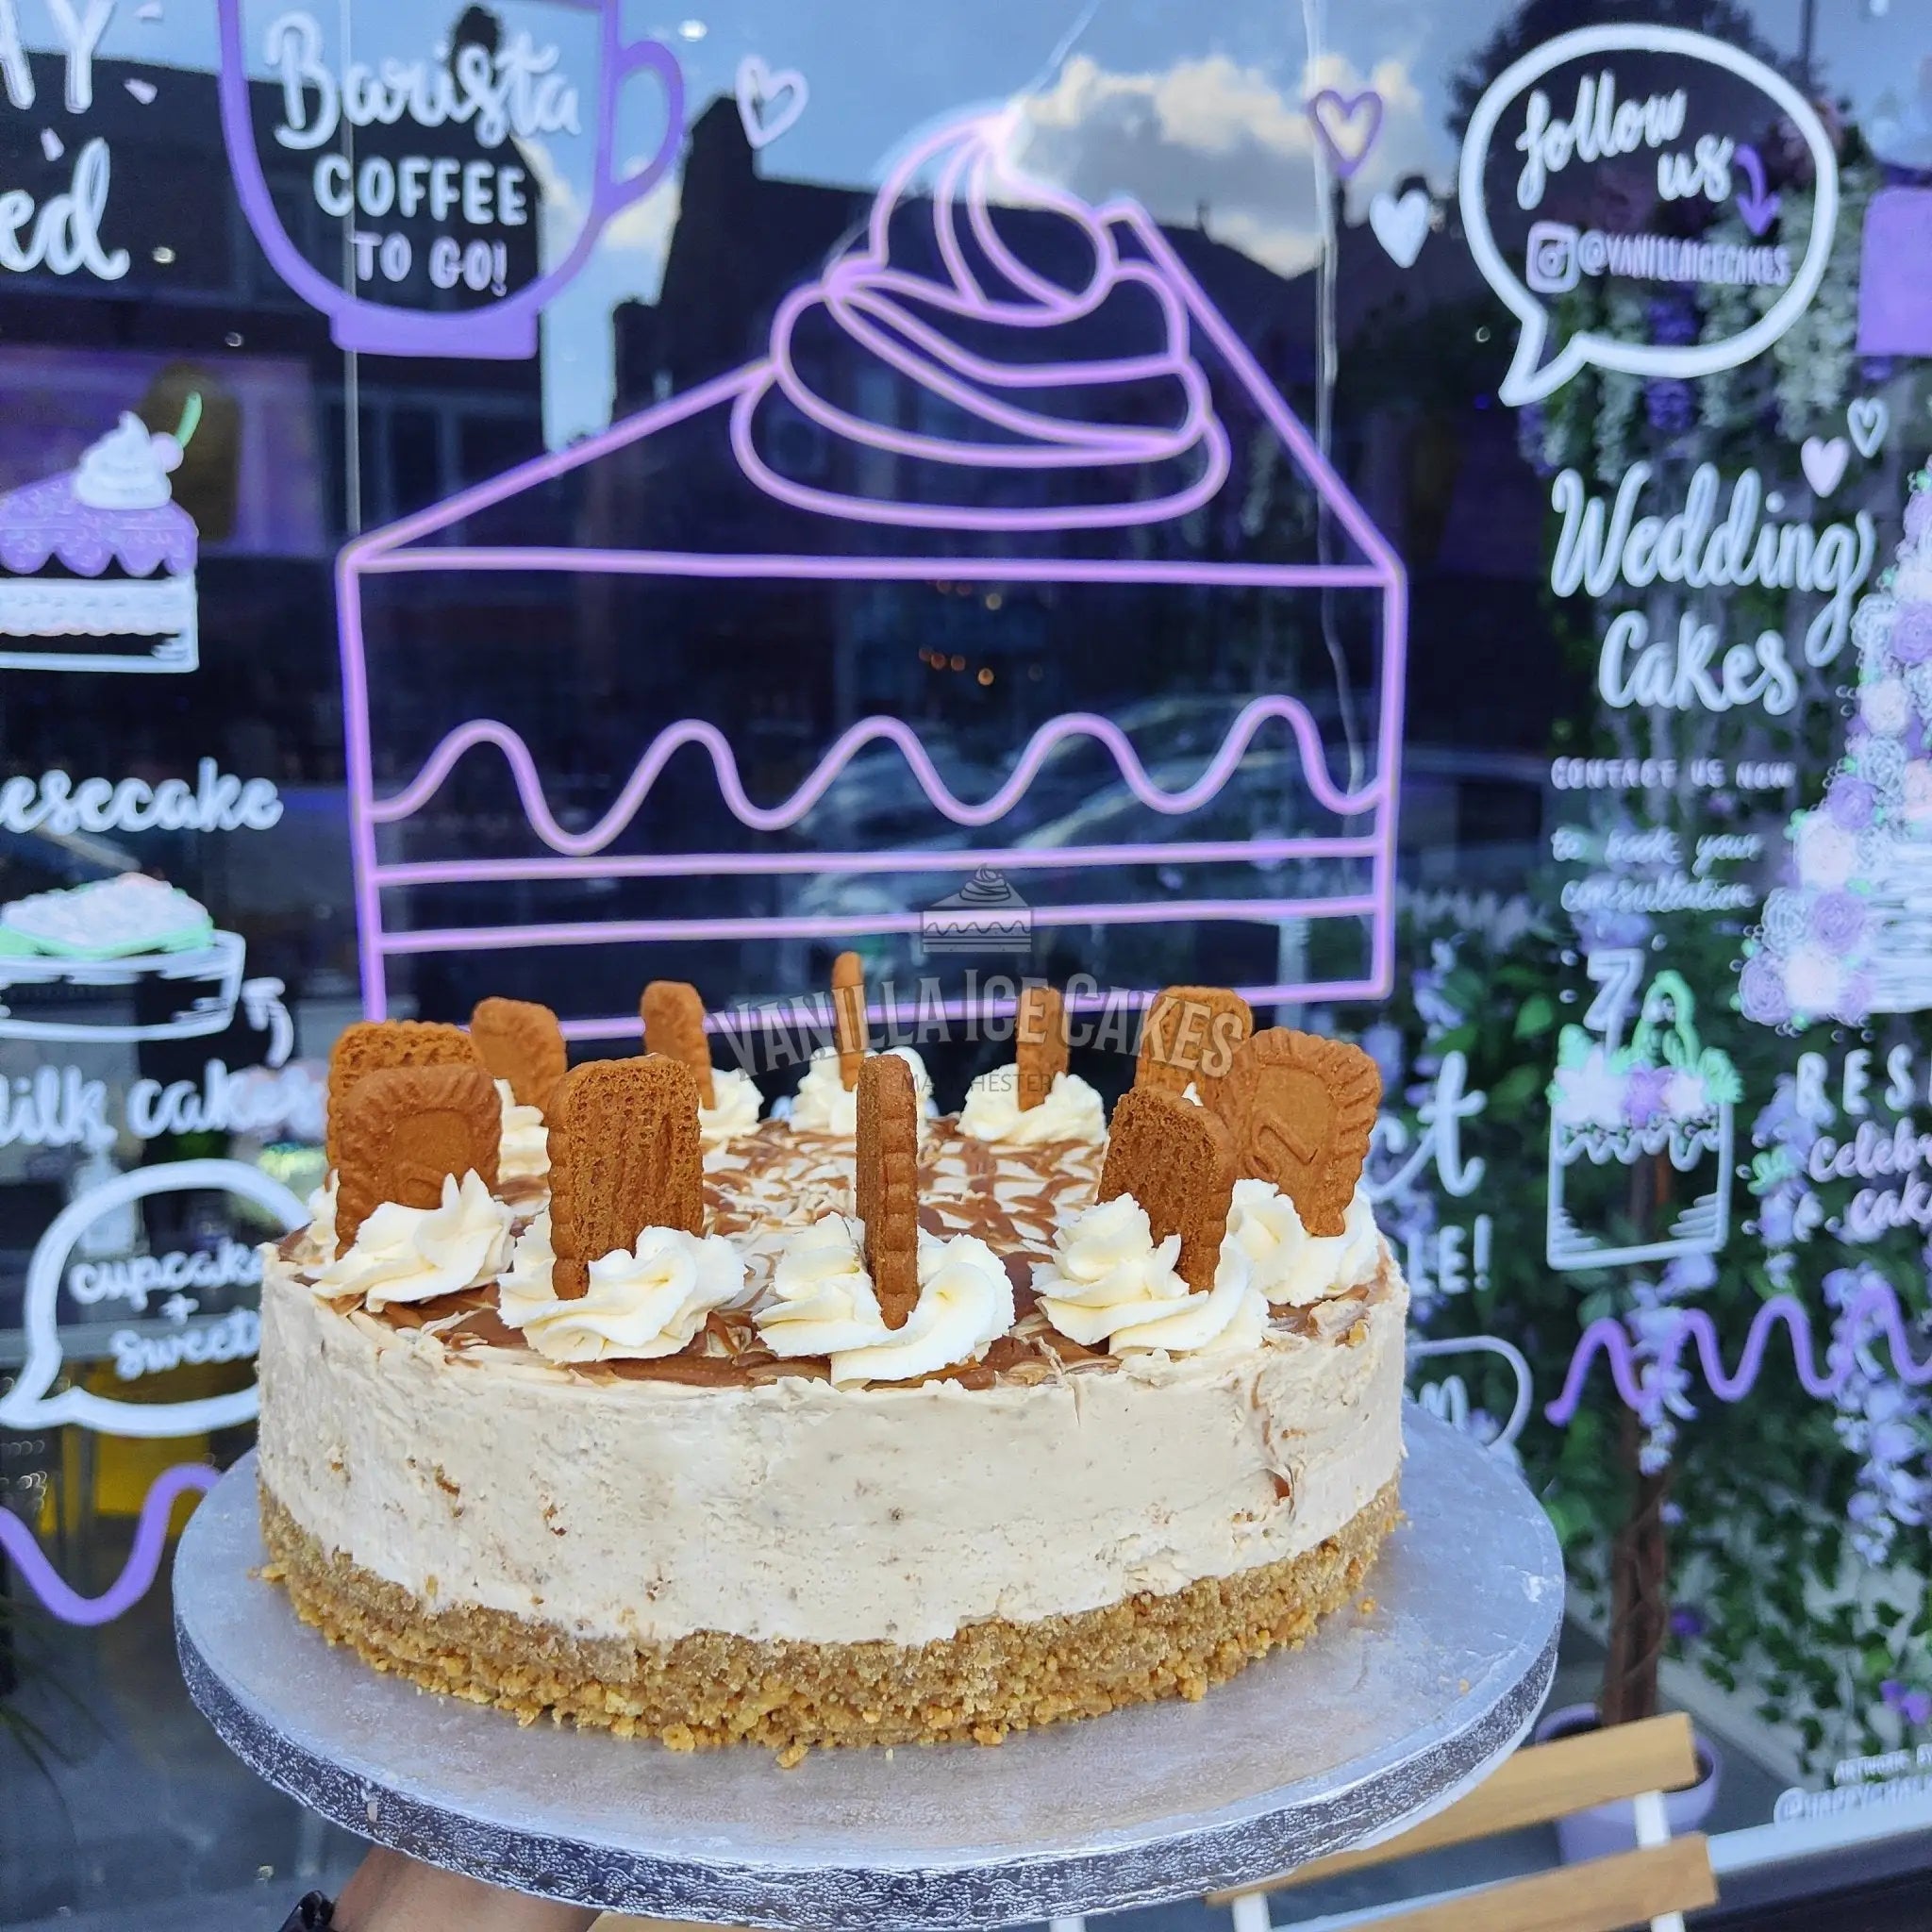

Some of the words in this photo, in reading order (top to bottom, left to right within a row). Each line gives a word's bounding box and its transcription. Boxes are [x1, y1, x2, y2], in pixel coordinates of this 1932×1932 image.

[265, 12, 583, 149] Barista
[1515, 69, 1688, 210] follow
[1657, 135, 1736, 202] us
[314, 154, 528, 226] COFFEE
[350, 232, 412, 281] TO
[428, 236, 508, 297] GO!
[1550, 459, 1877, 668] Wedding
[1598, 609, 1799, 716] Cakes
[1551, 756, 1677, 791] CONTACT
[1690, 758, 1726, 791] US
[1736, 759, 1796, 791] NOW
[0, 1065, 118, 1148] ilk
